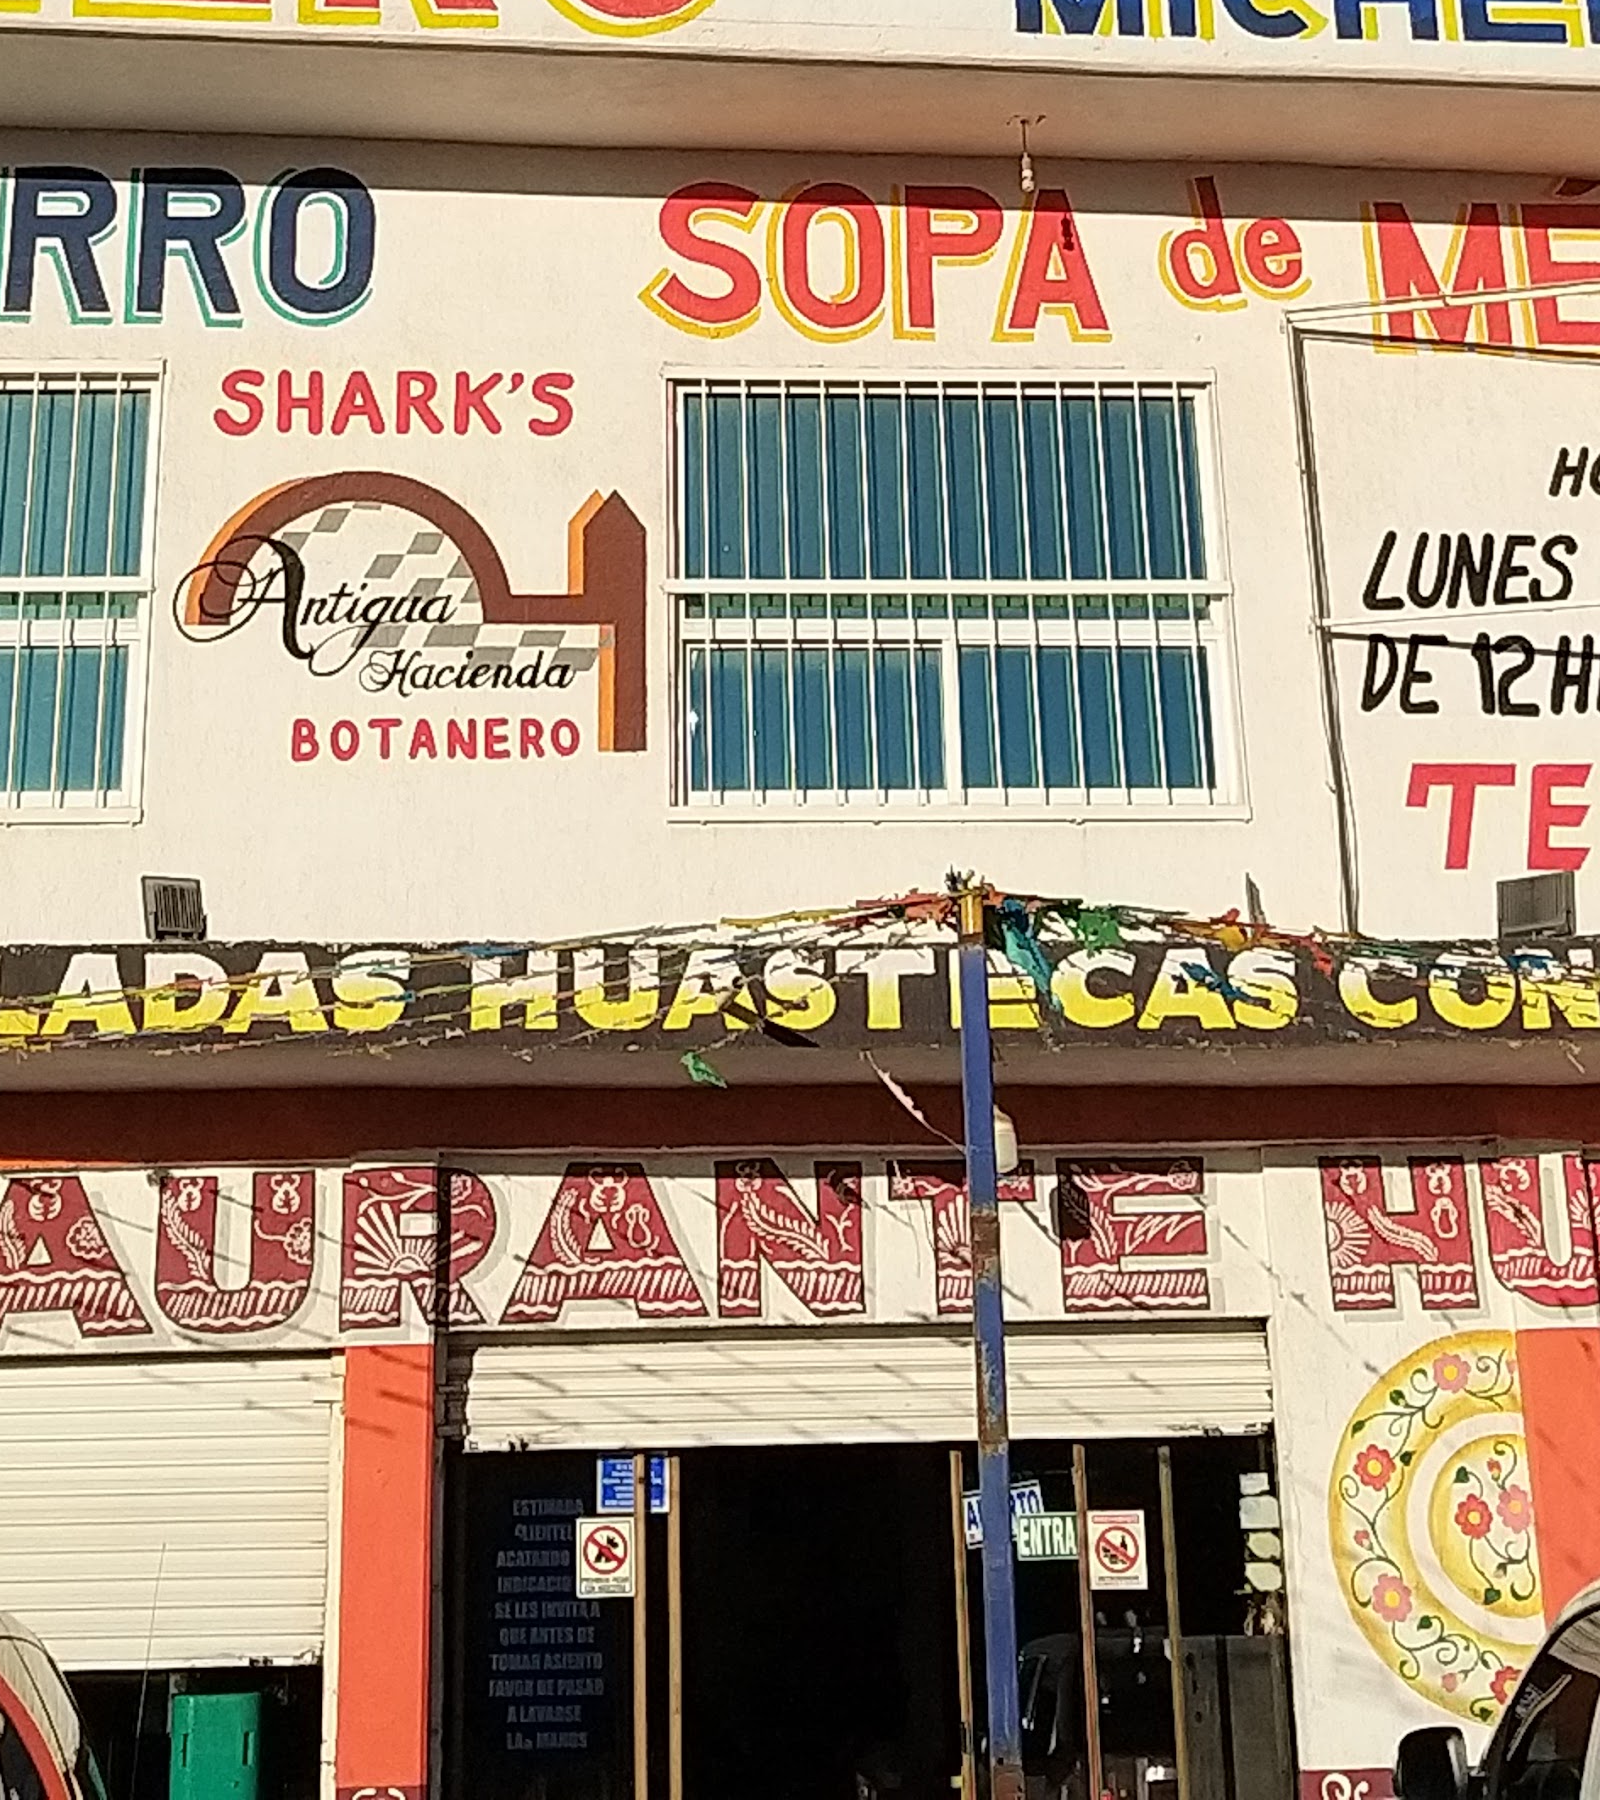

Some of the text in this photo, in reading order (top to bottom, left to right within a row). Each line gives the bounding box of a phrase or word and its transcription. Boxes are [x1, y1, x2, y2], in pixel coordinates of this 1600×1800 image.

[639, 180, 1113, 342] SOPA
[1159, 176, 1312, 313] de
[213, 369, 575, 437] SHARK'S
[173, 534, 457, 677] Antigua
[1362, 529, 1578, 612] LUNES
[359, 648, 577, 698] Hacienda
[1360, 634, 1449, 714] DE
[290, 717, 581, 762] BOTANERO
[471, 943, 1299, 1034] HUASTECAS
